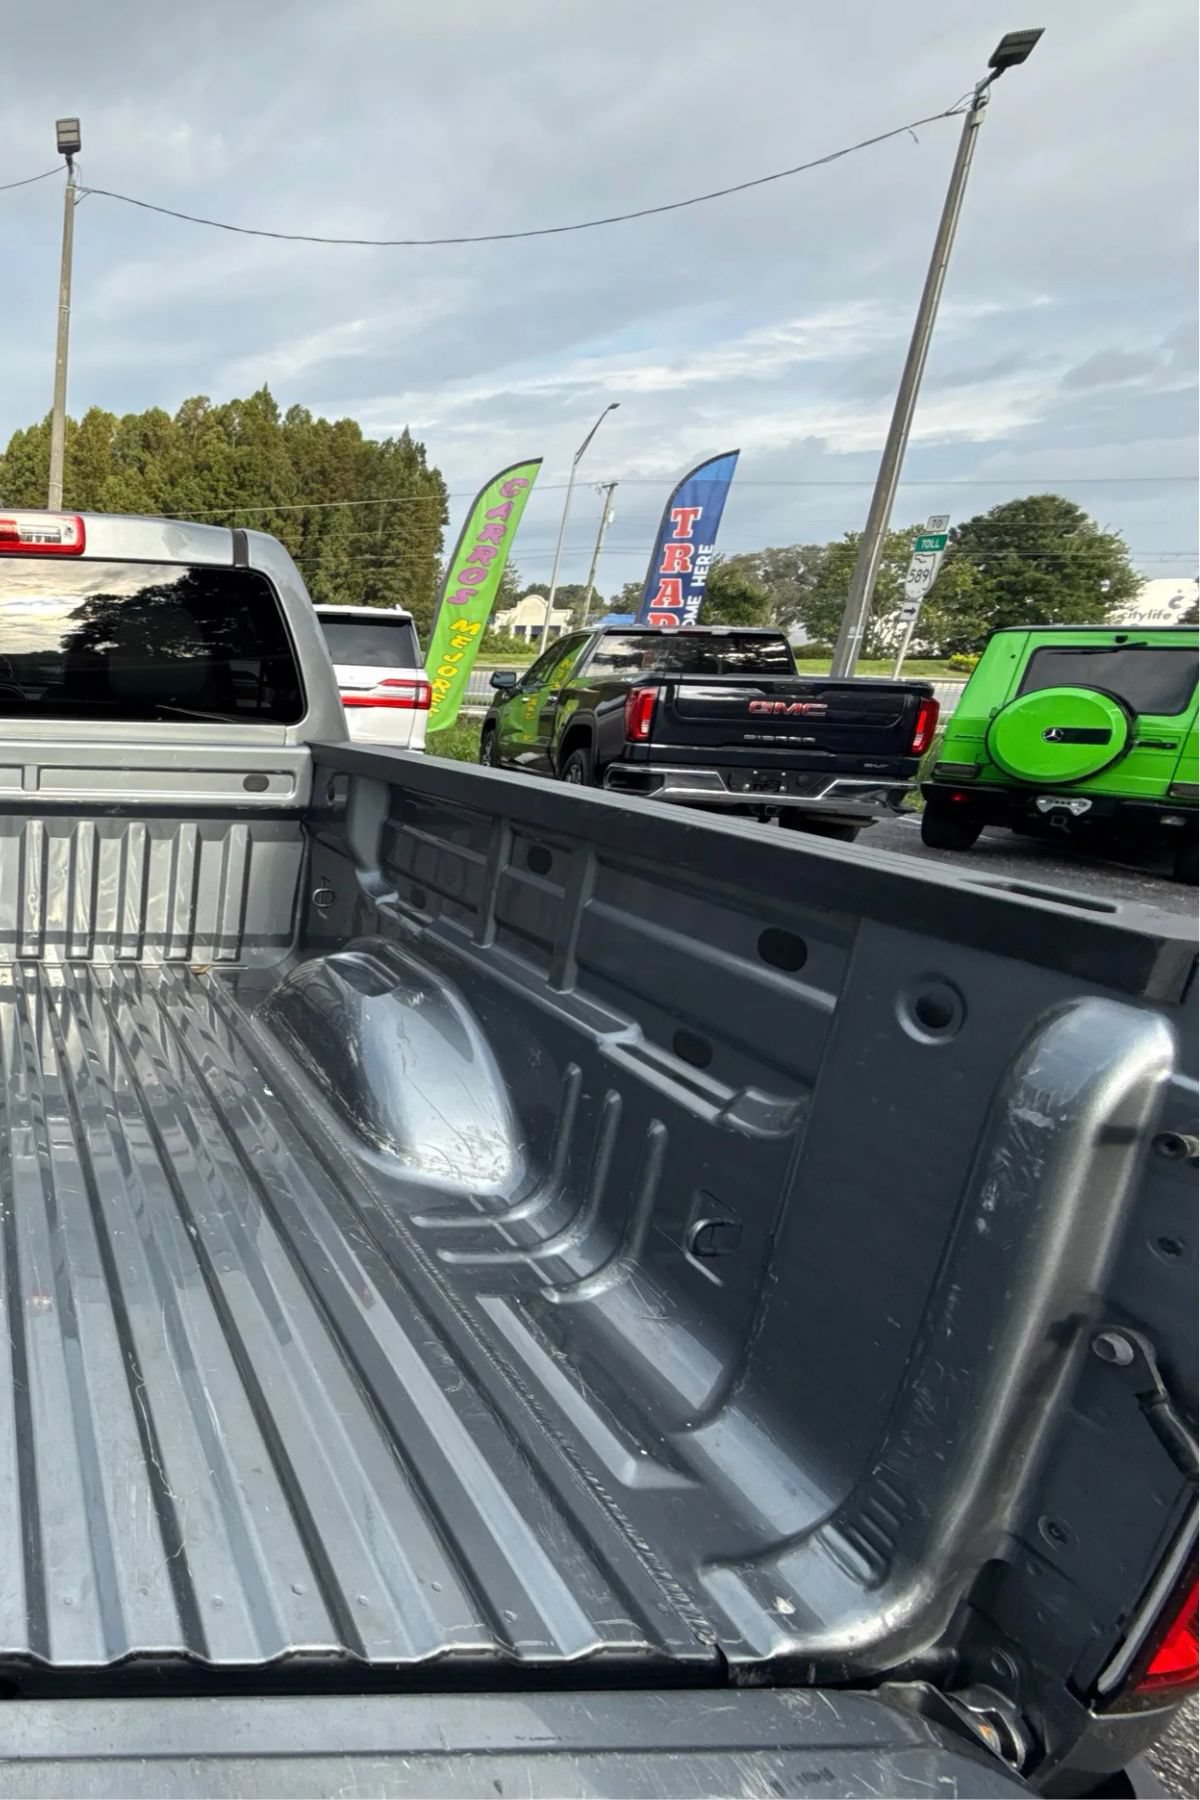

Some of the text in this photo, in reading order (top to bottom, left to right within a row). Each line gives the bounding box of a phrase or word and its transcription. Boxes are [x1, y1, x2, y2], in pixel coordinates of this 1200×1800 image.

[932, 519, 943, 529] TO
[447, 478, 529, 605] CARROS
[921, 539, 940, 549] TOLL
[907, 569, 930, 583] 589
[682, 545, 714, 626] OME HERE
[748, 700, 828, 717] GMC
